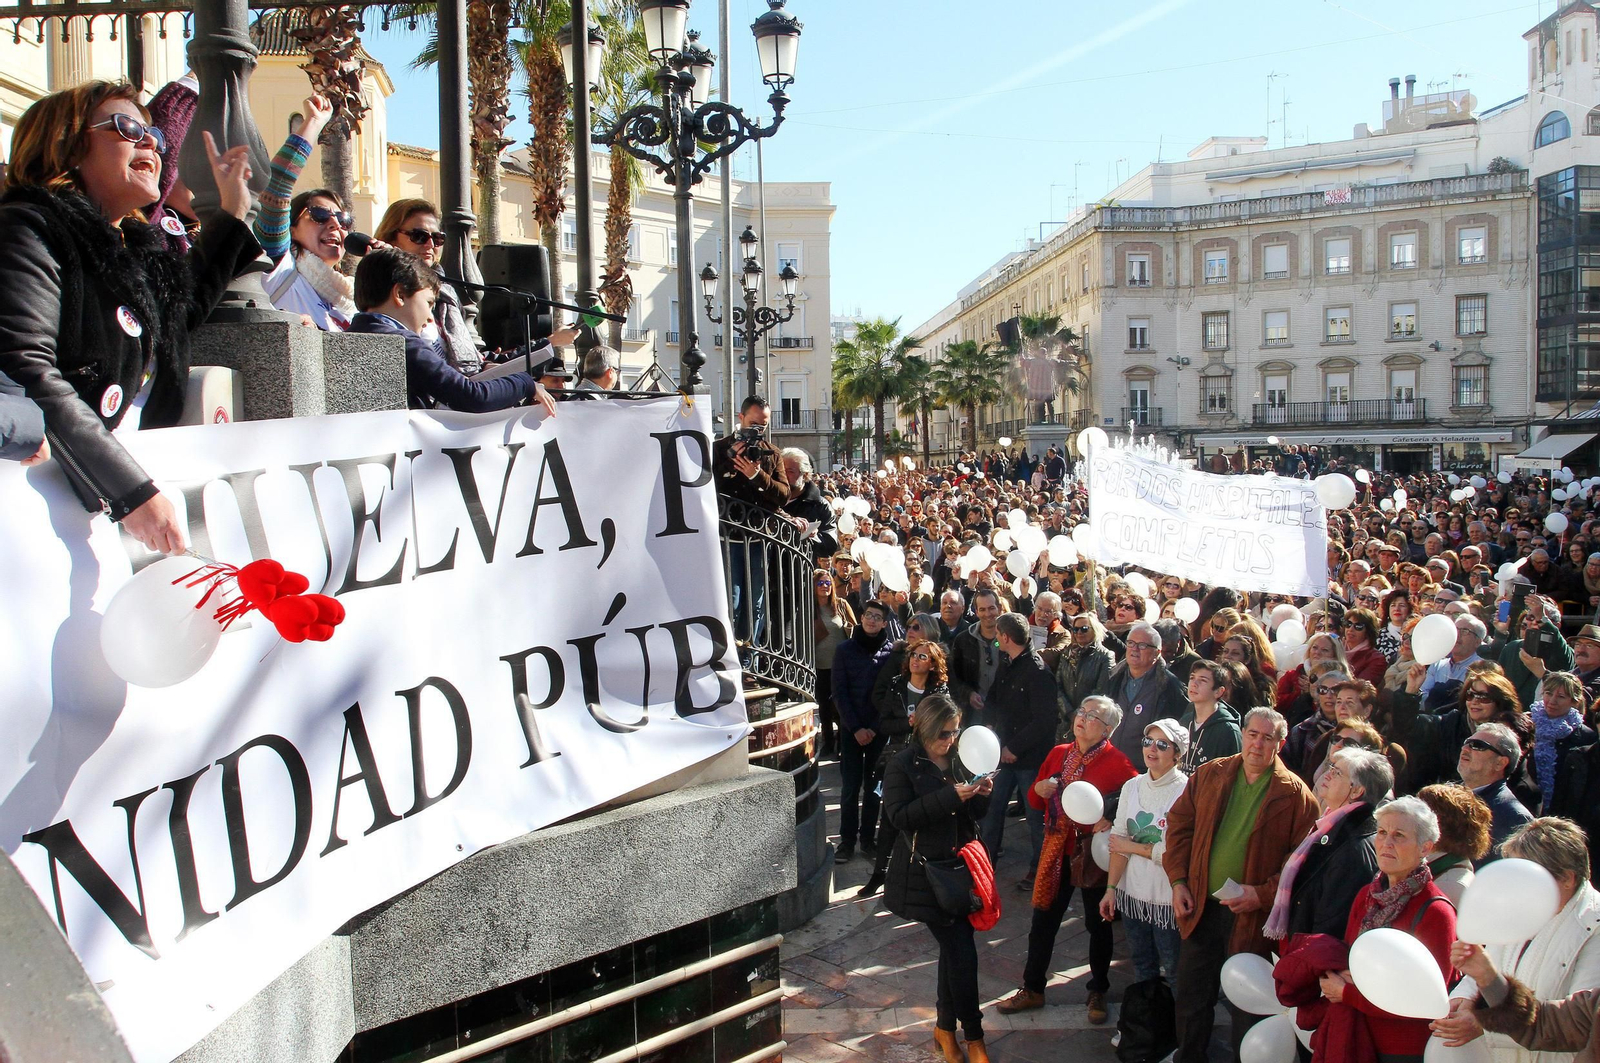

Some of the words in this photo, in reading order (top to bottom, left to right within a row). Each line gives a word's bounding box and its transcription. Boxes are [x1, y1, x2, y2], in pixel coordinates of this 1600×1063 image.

[649, 429, 713, 538] P
[1092, 457, 1136, 498] POR
[1136, 468, 1181, 510] DOS
[1449, 462, 1484, 470] Churros
[1100, 511, 1275, 575] COMPLETOS
[500, 593, 737, 769] PÚB
